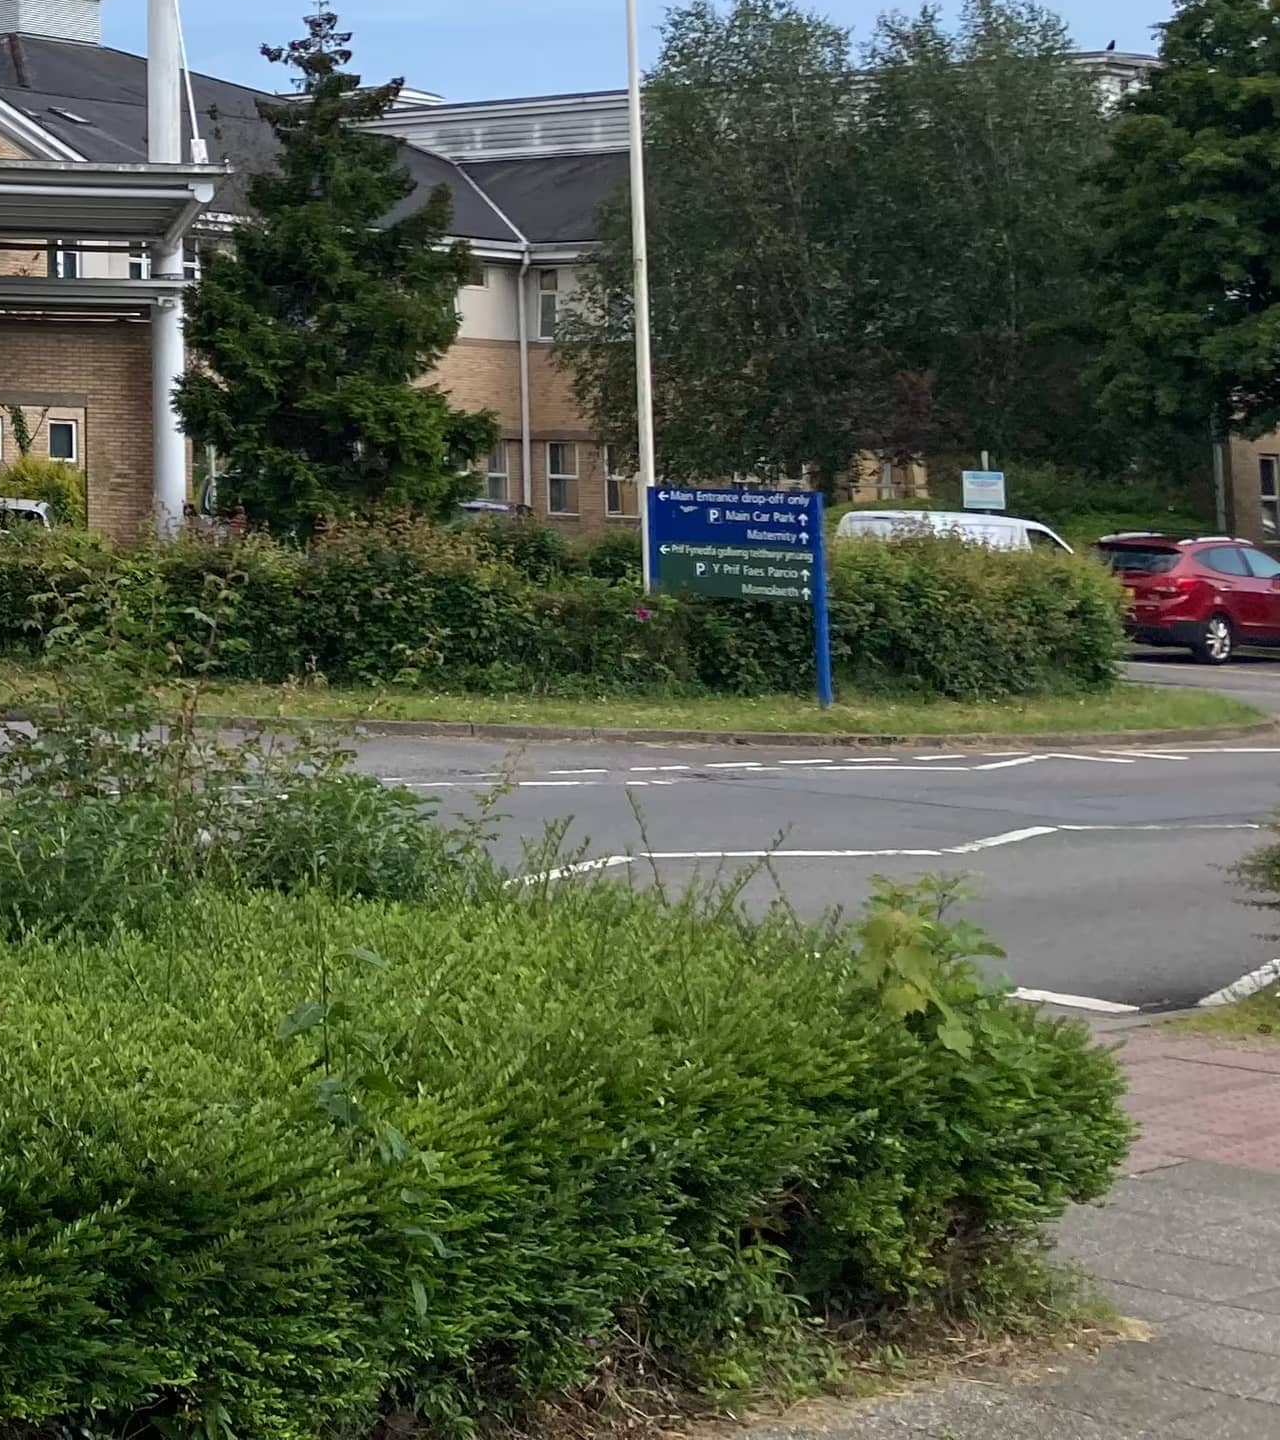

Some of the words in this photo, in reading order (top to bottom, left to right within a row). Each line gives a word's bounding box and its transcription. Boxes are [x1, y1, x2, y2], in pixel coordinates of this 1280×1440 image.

[671, 491, 693, 501] Main
[697, 492, 738, 503] Entrance
[742, 493, 784, 505] drop-off
[788, 495, 809, 507] only
[726, 510, 750, 521] Main
[753, 511, 770, 521] Car
[774, 512, 795, 523] Park
[747, 529, 797, 543] Maternity
[713, 564, 720, 573] Y
[724, 564, 741, 575] Prif
[744, 566, 764, 576] Faes
[768, 567, 798, 578] Parcio
